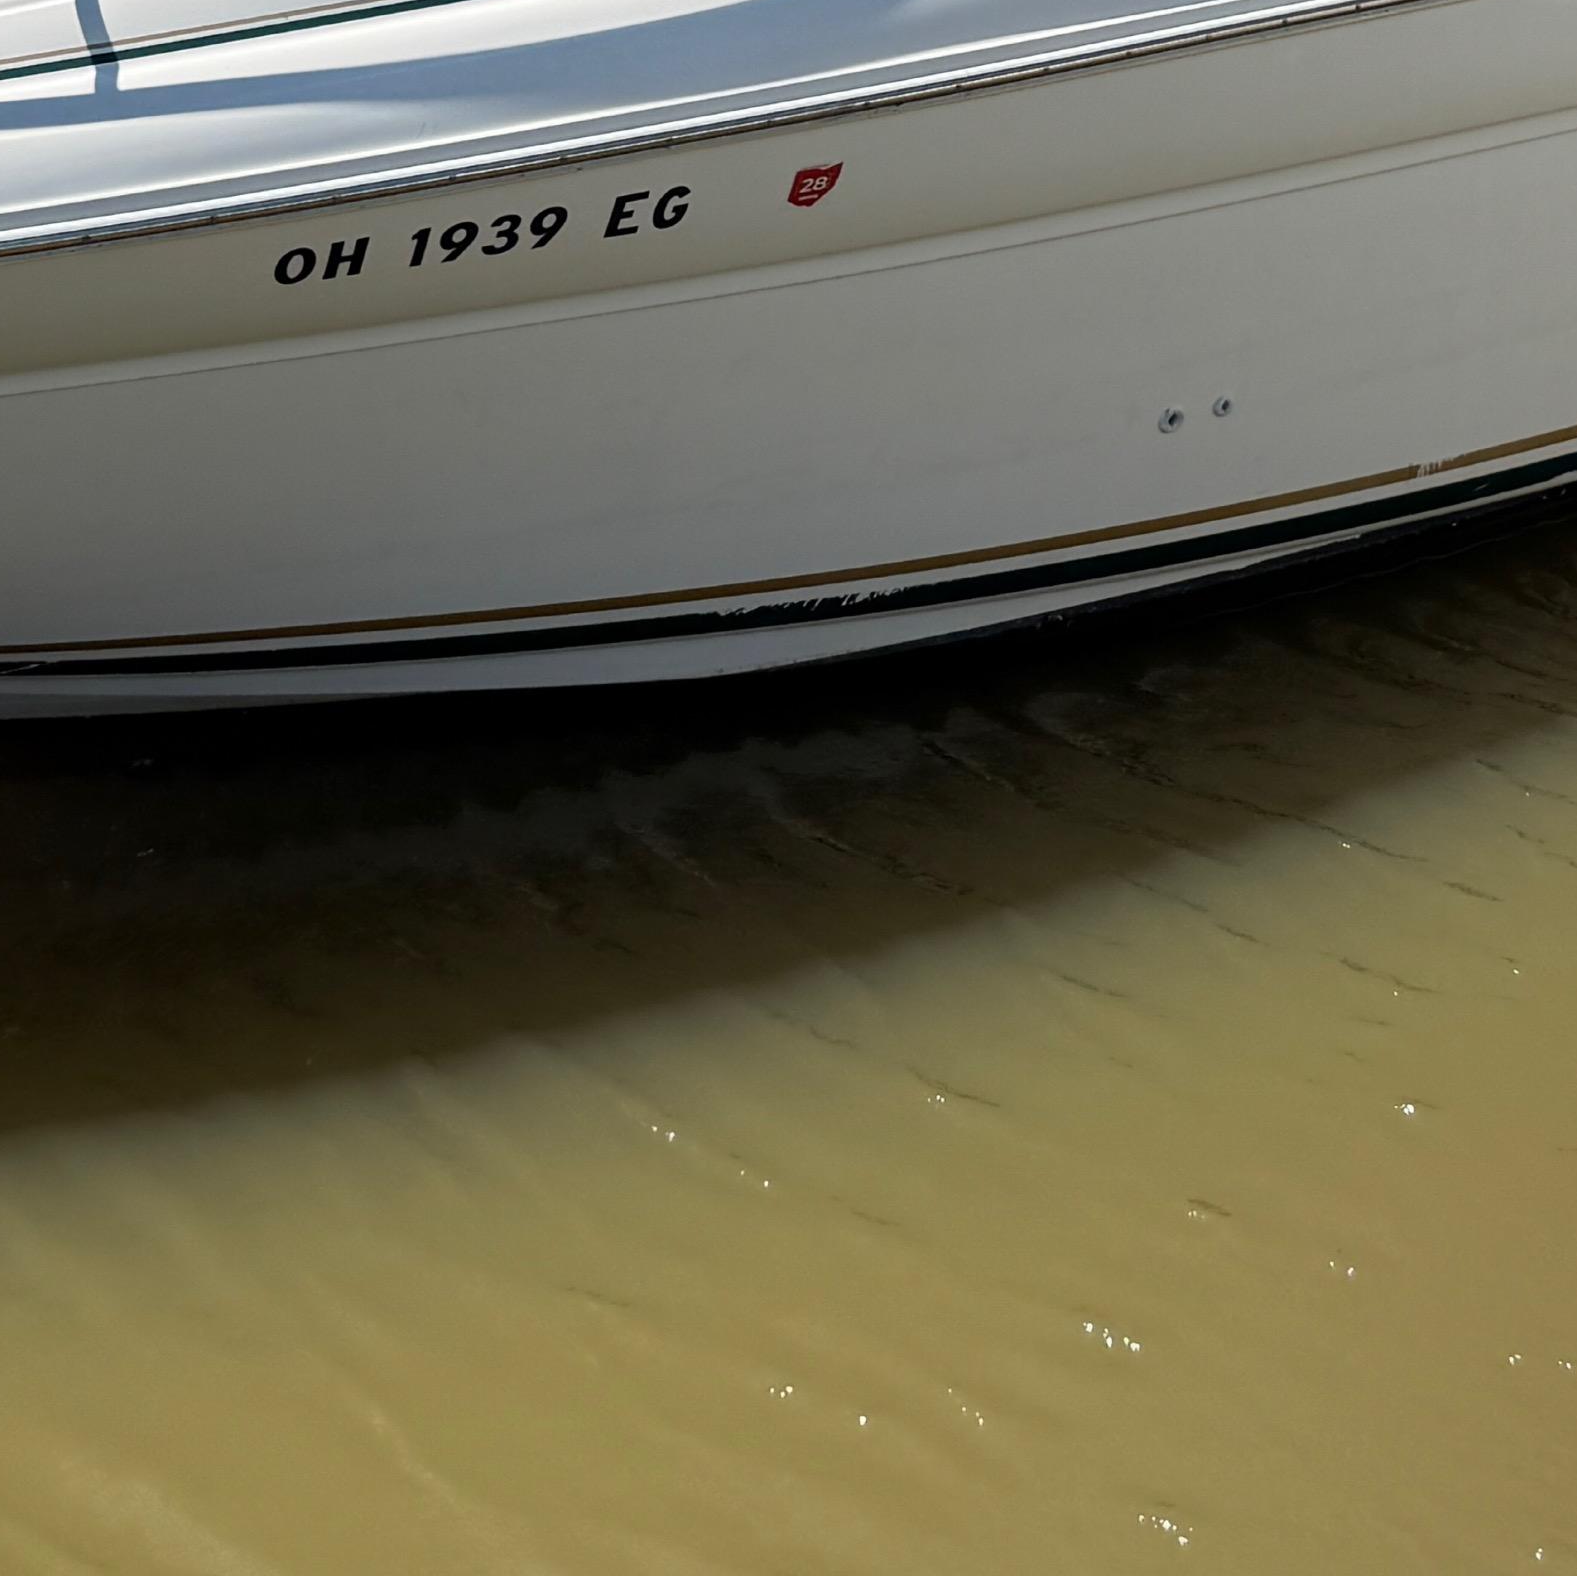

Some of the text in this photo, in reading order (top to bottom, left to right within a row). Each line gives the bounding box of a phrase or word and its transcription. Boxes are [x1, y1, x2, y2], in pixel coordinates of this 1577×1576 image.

[799, 176, 828, 193] 28
[273, 185, 692, 286] OH 1939 EG
